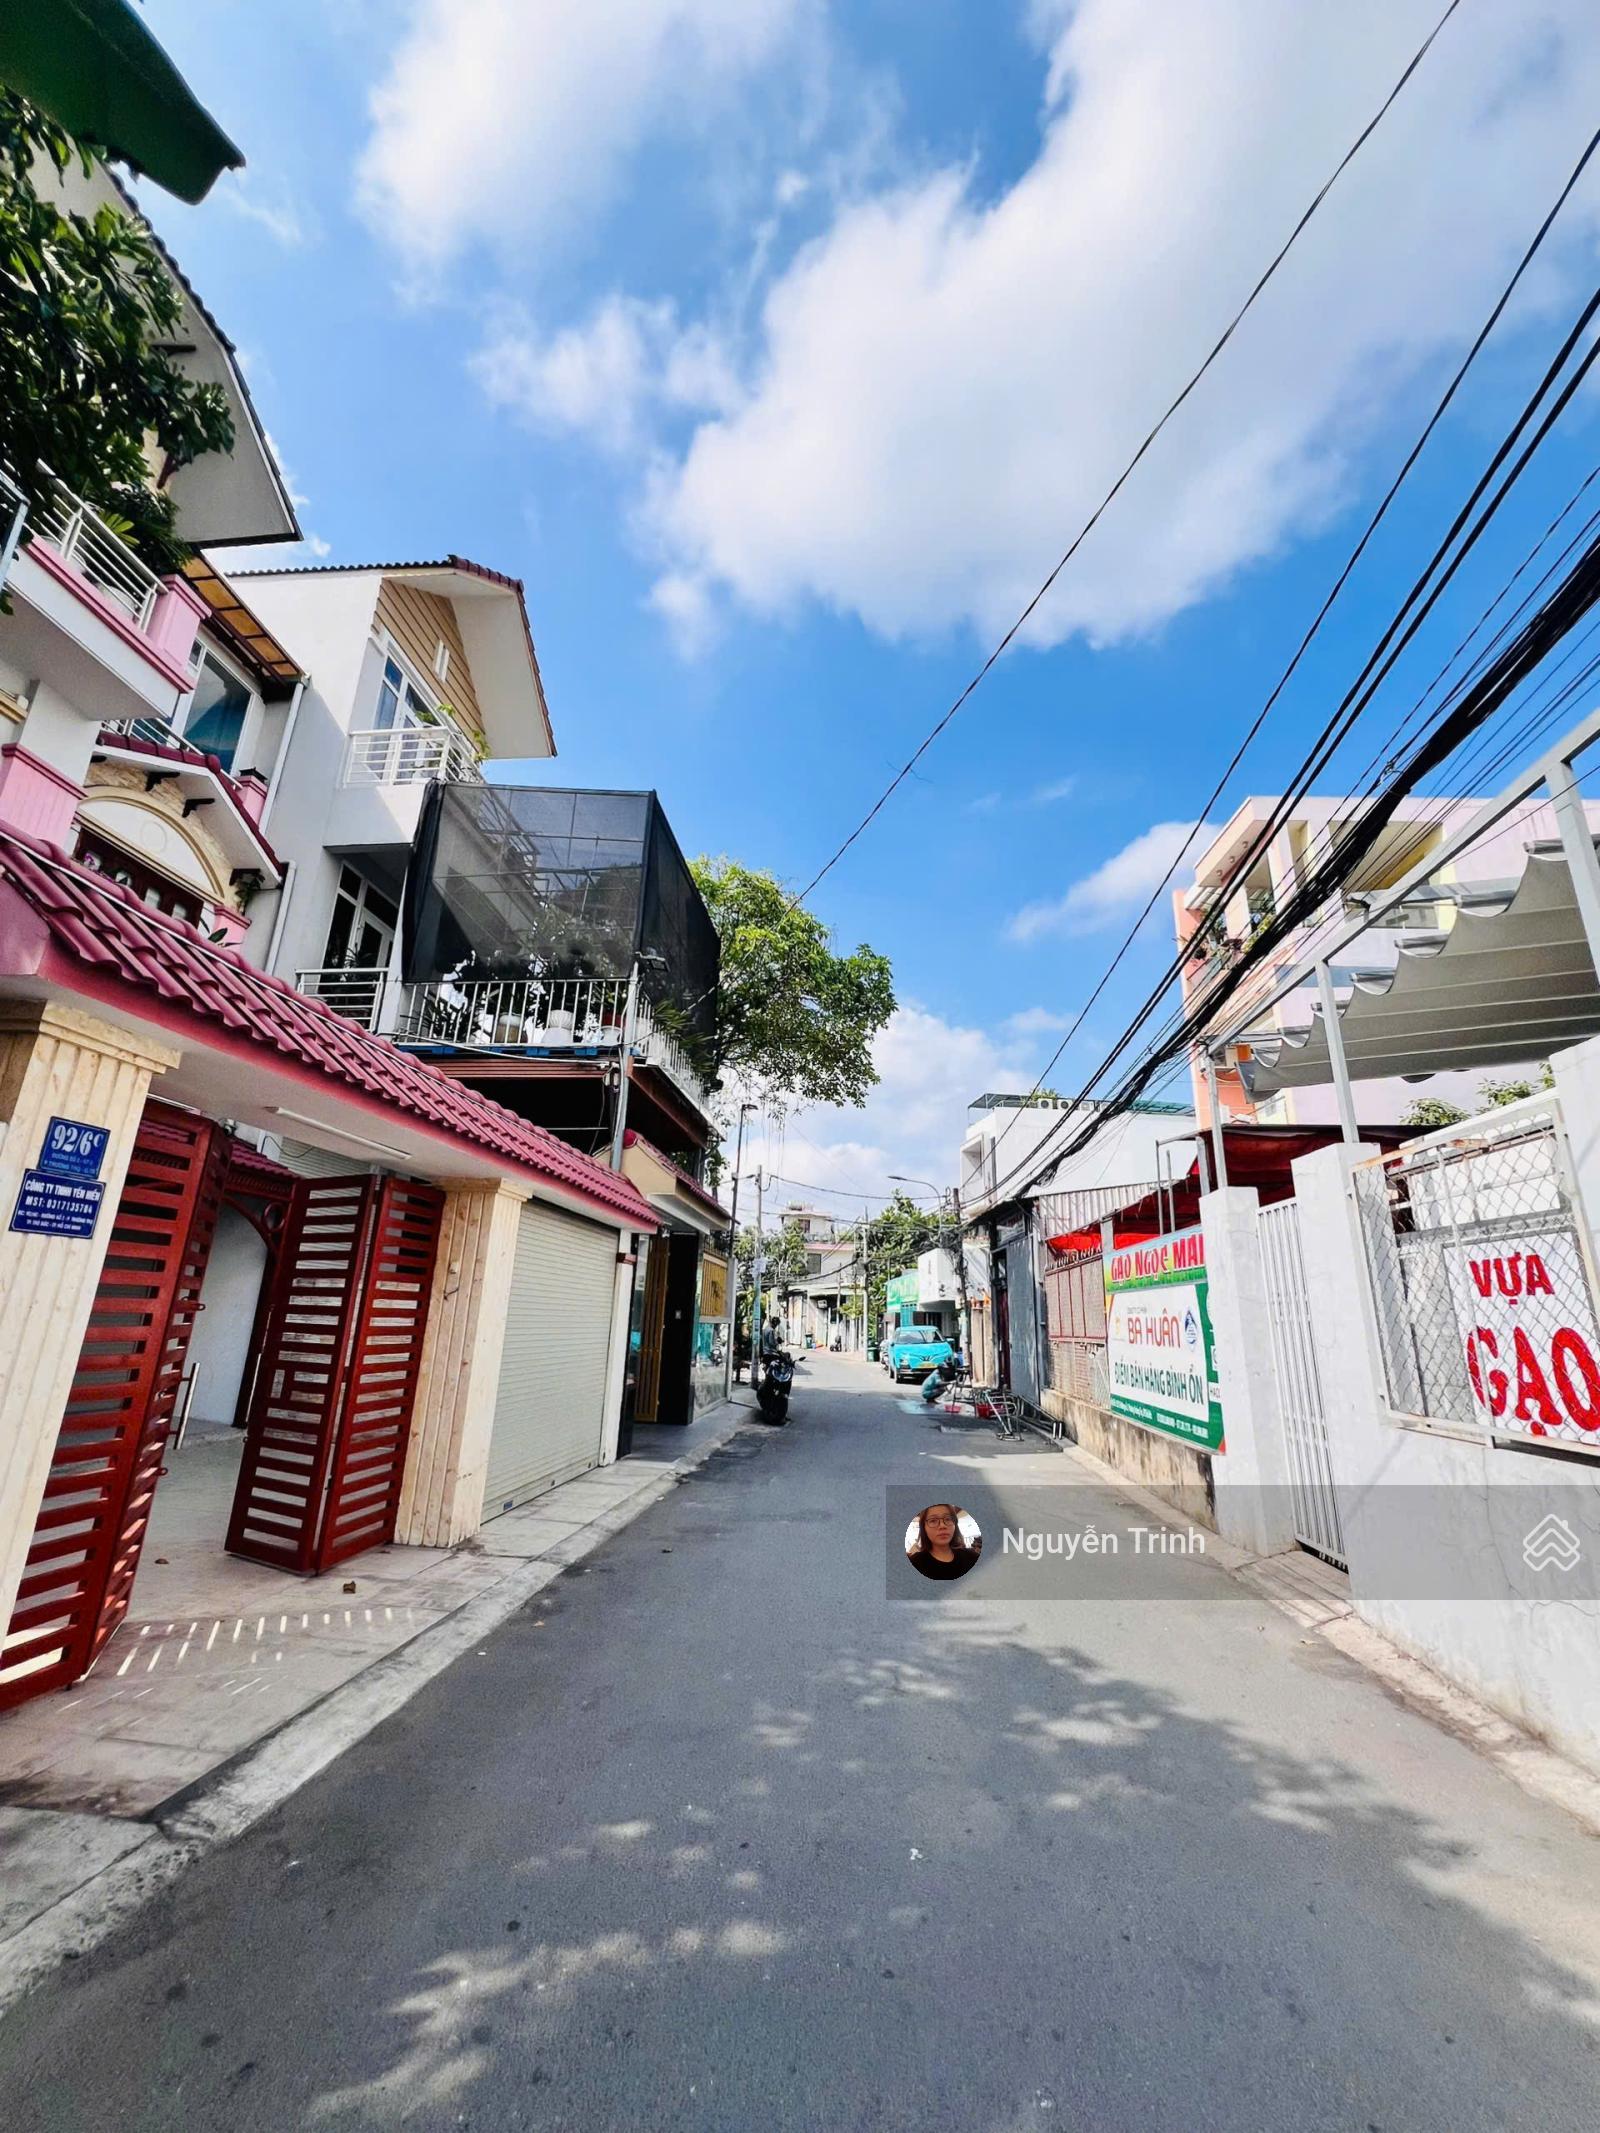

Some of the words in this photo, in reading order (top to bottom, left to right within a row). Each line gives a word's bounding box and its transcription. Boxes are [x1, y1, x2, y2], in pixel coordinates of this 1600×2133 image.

[45, 1183, 54, 1194] TY
[1111, 1254, 1131, 1286] GẠO
[1135, 1244, 1169, 1280] NGỌC
[1172, 1233, 1205, 1269] MAI
[1469, 1251, 1555, 1305] VỰA
[1127, 1316, 1143, 1344] BA
[1146, 1308, 1181, 1349] HUÂN
[1130, 1360, 1144, 1389] BÁN
[1144, 1362, 1166, 1395] HÀNG
[1166, 1365, 1188, 1401] BÌNH
[1188, 1363, 1204, 1405] ỔN
[1465, 1325, 1600, 1437] GẠO
